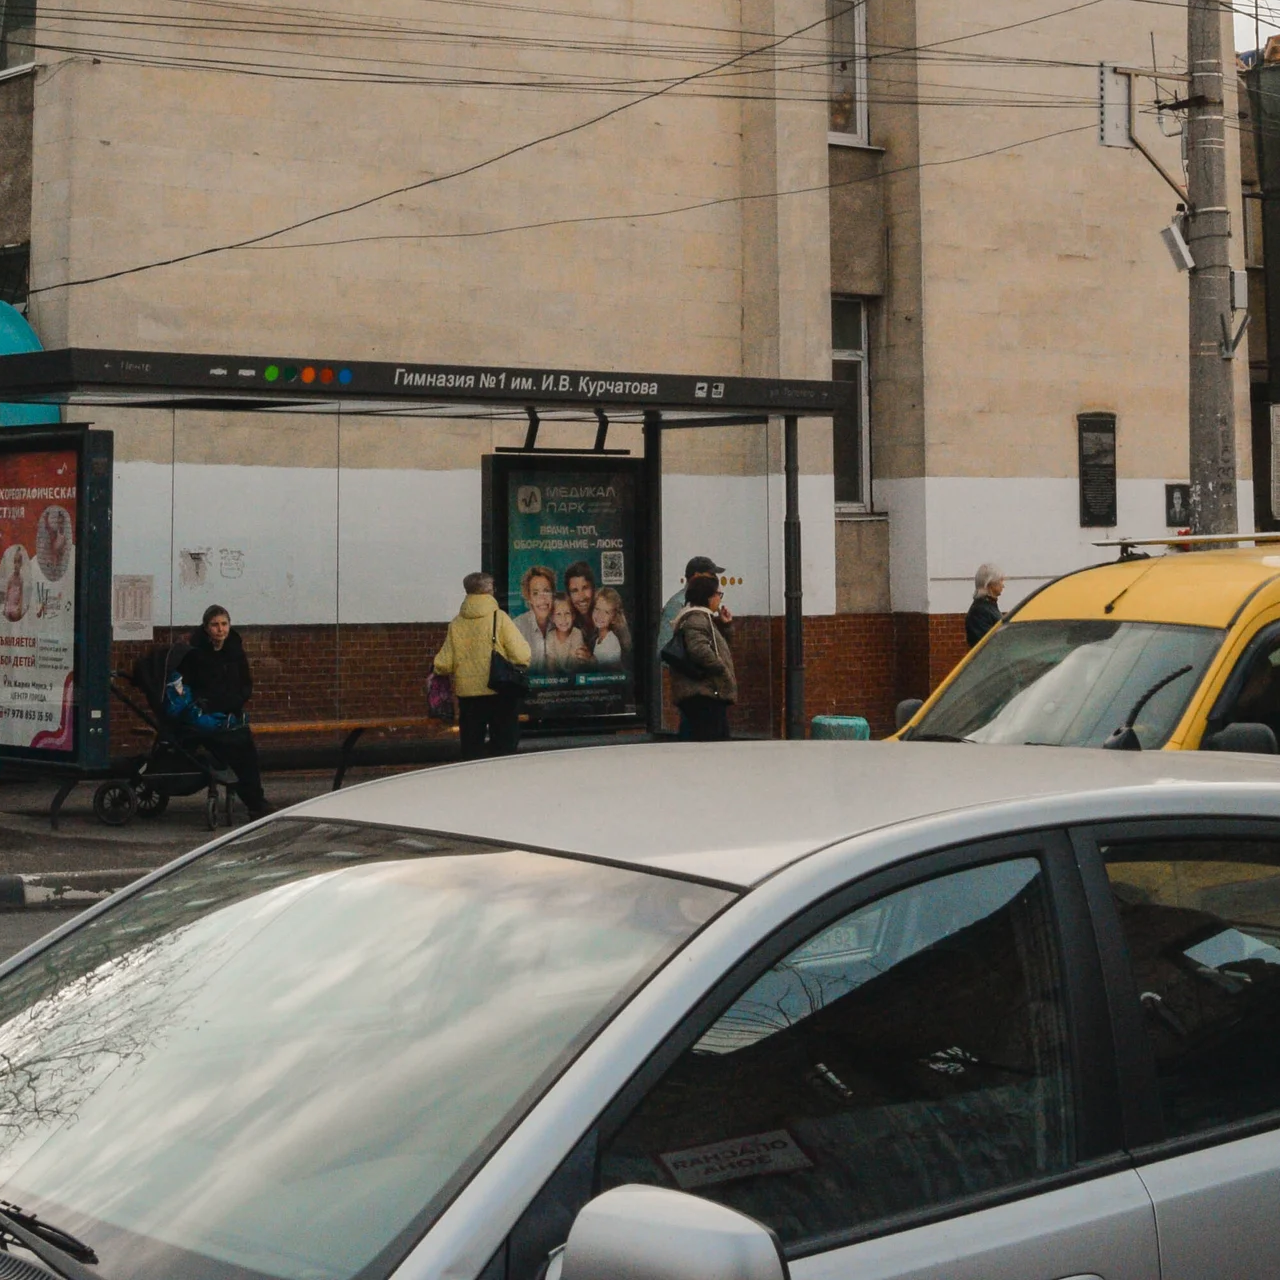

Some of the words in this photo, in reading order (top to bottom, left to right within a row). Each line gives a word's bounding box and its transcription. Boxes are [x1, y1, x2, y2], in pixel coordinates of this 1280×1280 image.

[393, 368, 475, 388] Гимназия
[510, 376, 536, 390] им.
[541, 374, 573, 392] И.В.
[578, 375, 658, 397] Курчатова
[546, 486, 616, 498] МЕДИКАЛ
[546, 502, 585, 513] ПАРК
[540, 525, 569, 536] ВРАЧИ
[513, 540, 589, 551] ОБОРУДОВАНИЕ
[596, 539, 623, 549] ЛЮКС
[12, 655, 36, 668] ДЕТЕЙ
